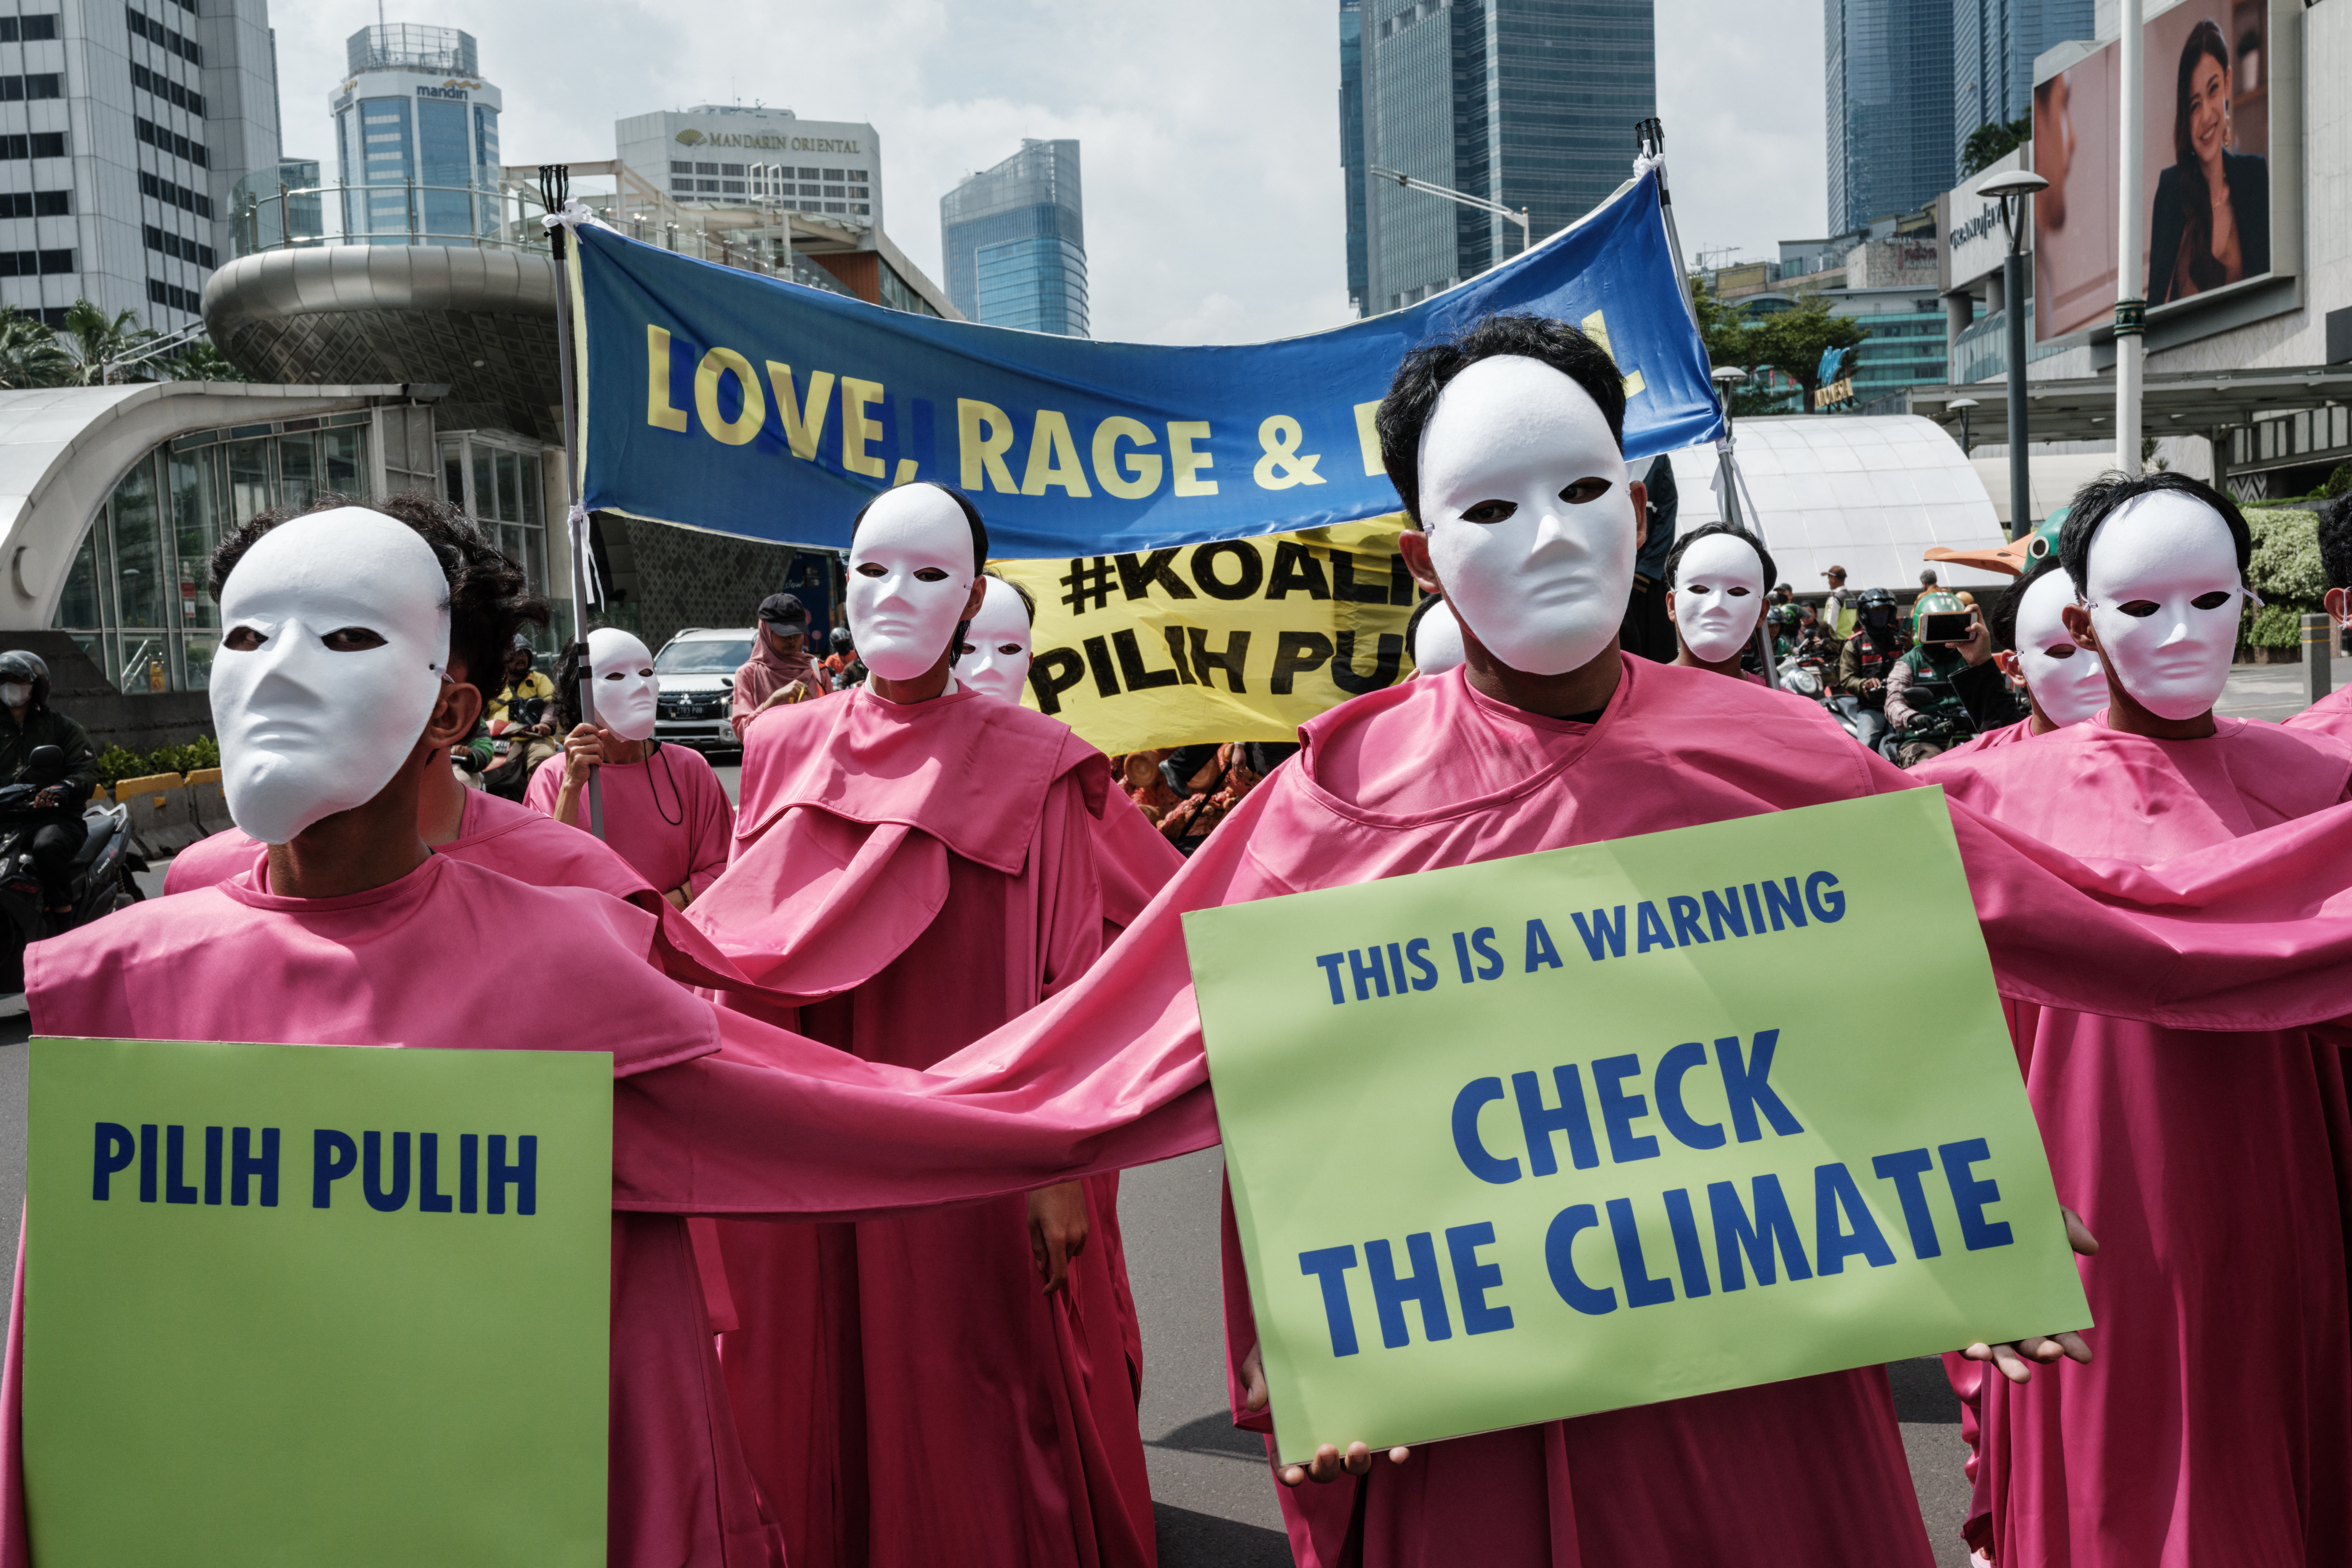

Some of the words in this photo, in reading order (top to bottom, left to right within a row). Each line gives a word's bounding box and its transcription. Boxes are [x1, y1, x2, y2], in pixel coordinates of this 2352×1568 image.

[417, 85, 468, 100] mandiri
[709, 132, 787, 149] MANDARIN
[791, 137, 860, 153] ORIENTAL
[647, 324, 919, 488] LOVE,
[957, 398, 1219, 500] RAGE
[1253, 414, 1327, 490] &
[1059, 540, 1436, 616] #KOALI
[1027, 625, 1251, 716] PILIH
[1316, 937, 1438, 1005] THIS
[1452, 927, 1503, 985] IS
[1524, 918, 1563, 974] A
[1570, 870, 1846, 962] WARNING
[1451, 1028, 1805, 1184] CHECK
[92, 1122, 280, 1207] PILIH
[312, 1129, 538, 1216] PULIH
[1299, 1220, 1515, 1358] THE
[1545, 1137, 2014, 1316] CLIMATE
